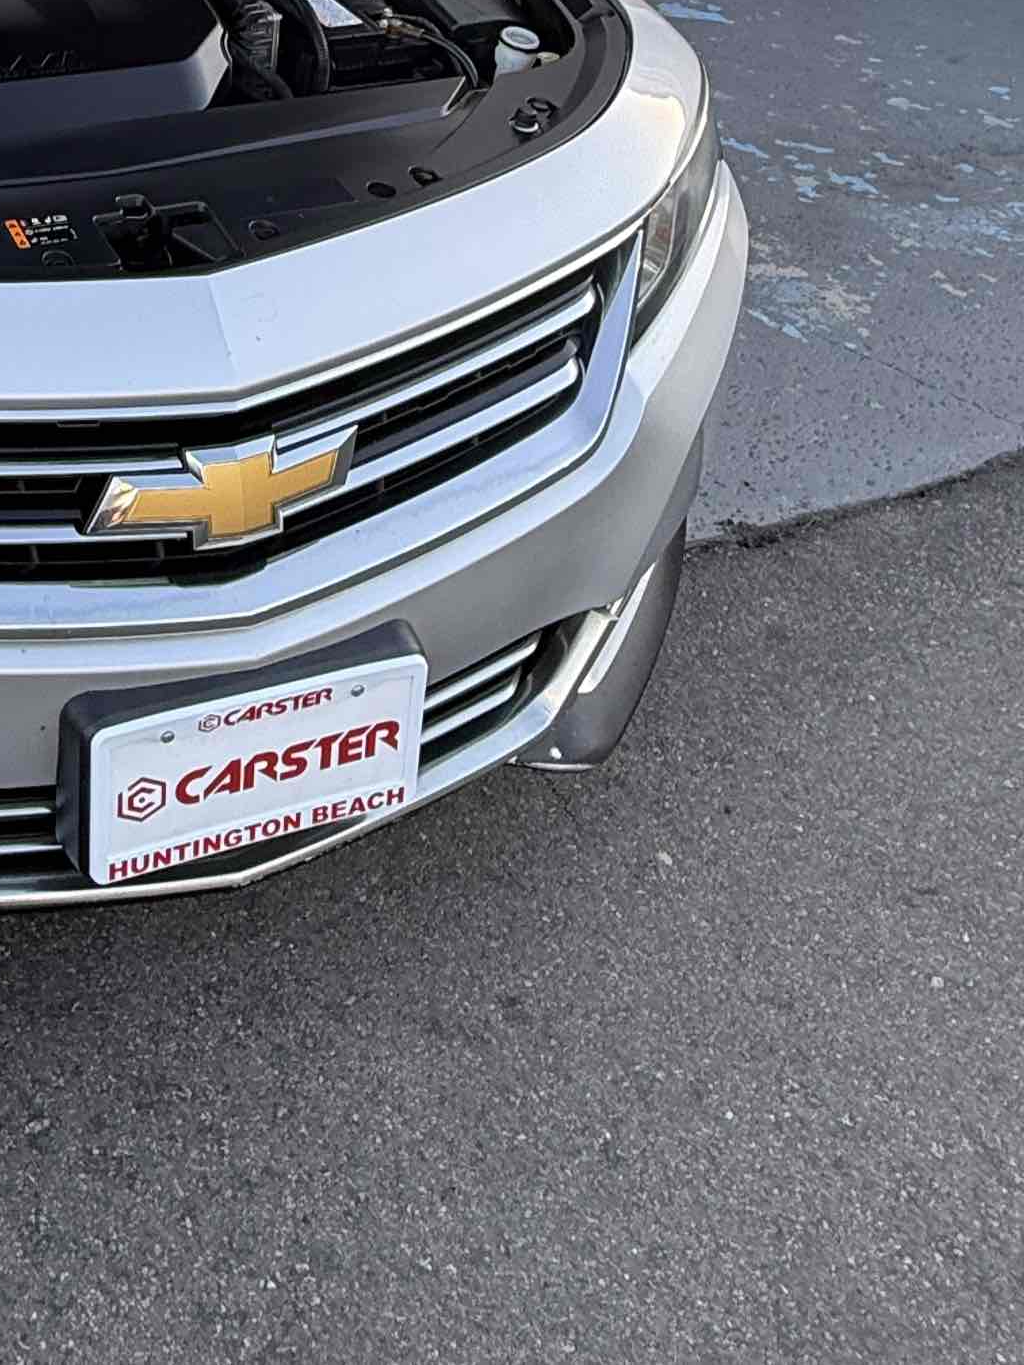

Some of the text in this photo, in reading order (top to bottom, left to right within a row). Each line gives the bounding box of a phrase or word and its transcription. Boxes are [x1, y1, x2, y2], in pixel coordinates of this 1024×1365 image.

[224, 687, 333, 726] CARSTER
[175, 720, 400, 805] CARSTER
[108, 787, 405, 881] HUNTINGTON BEACH
